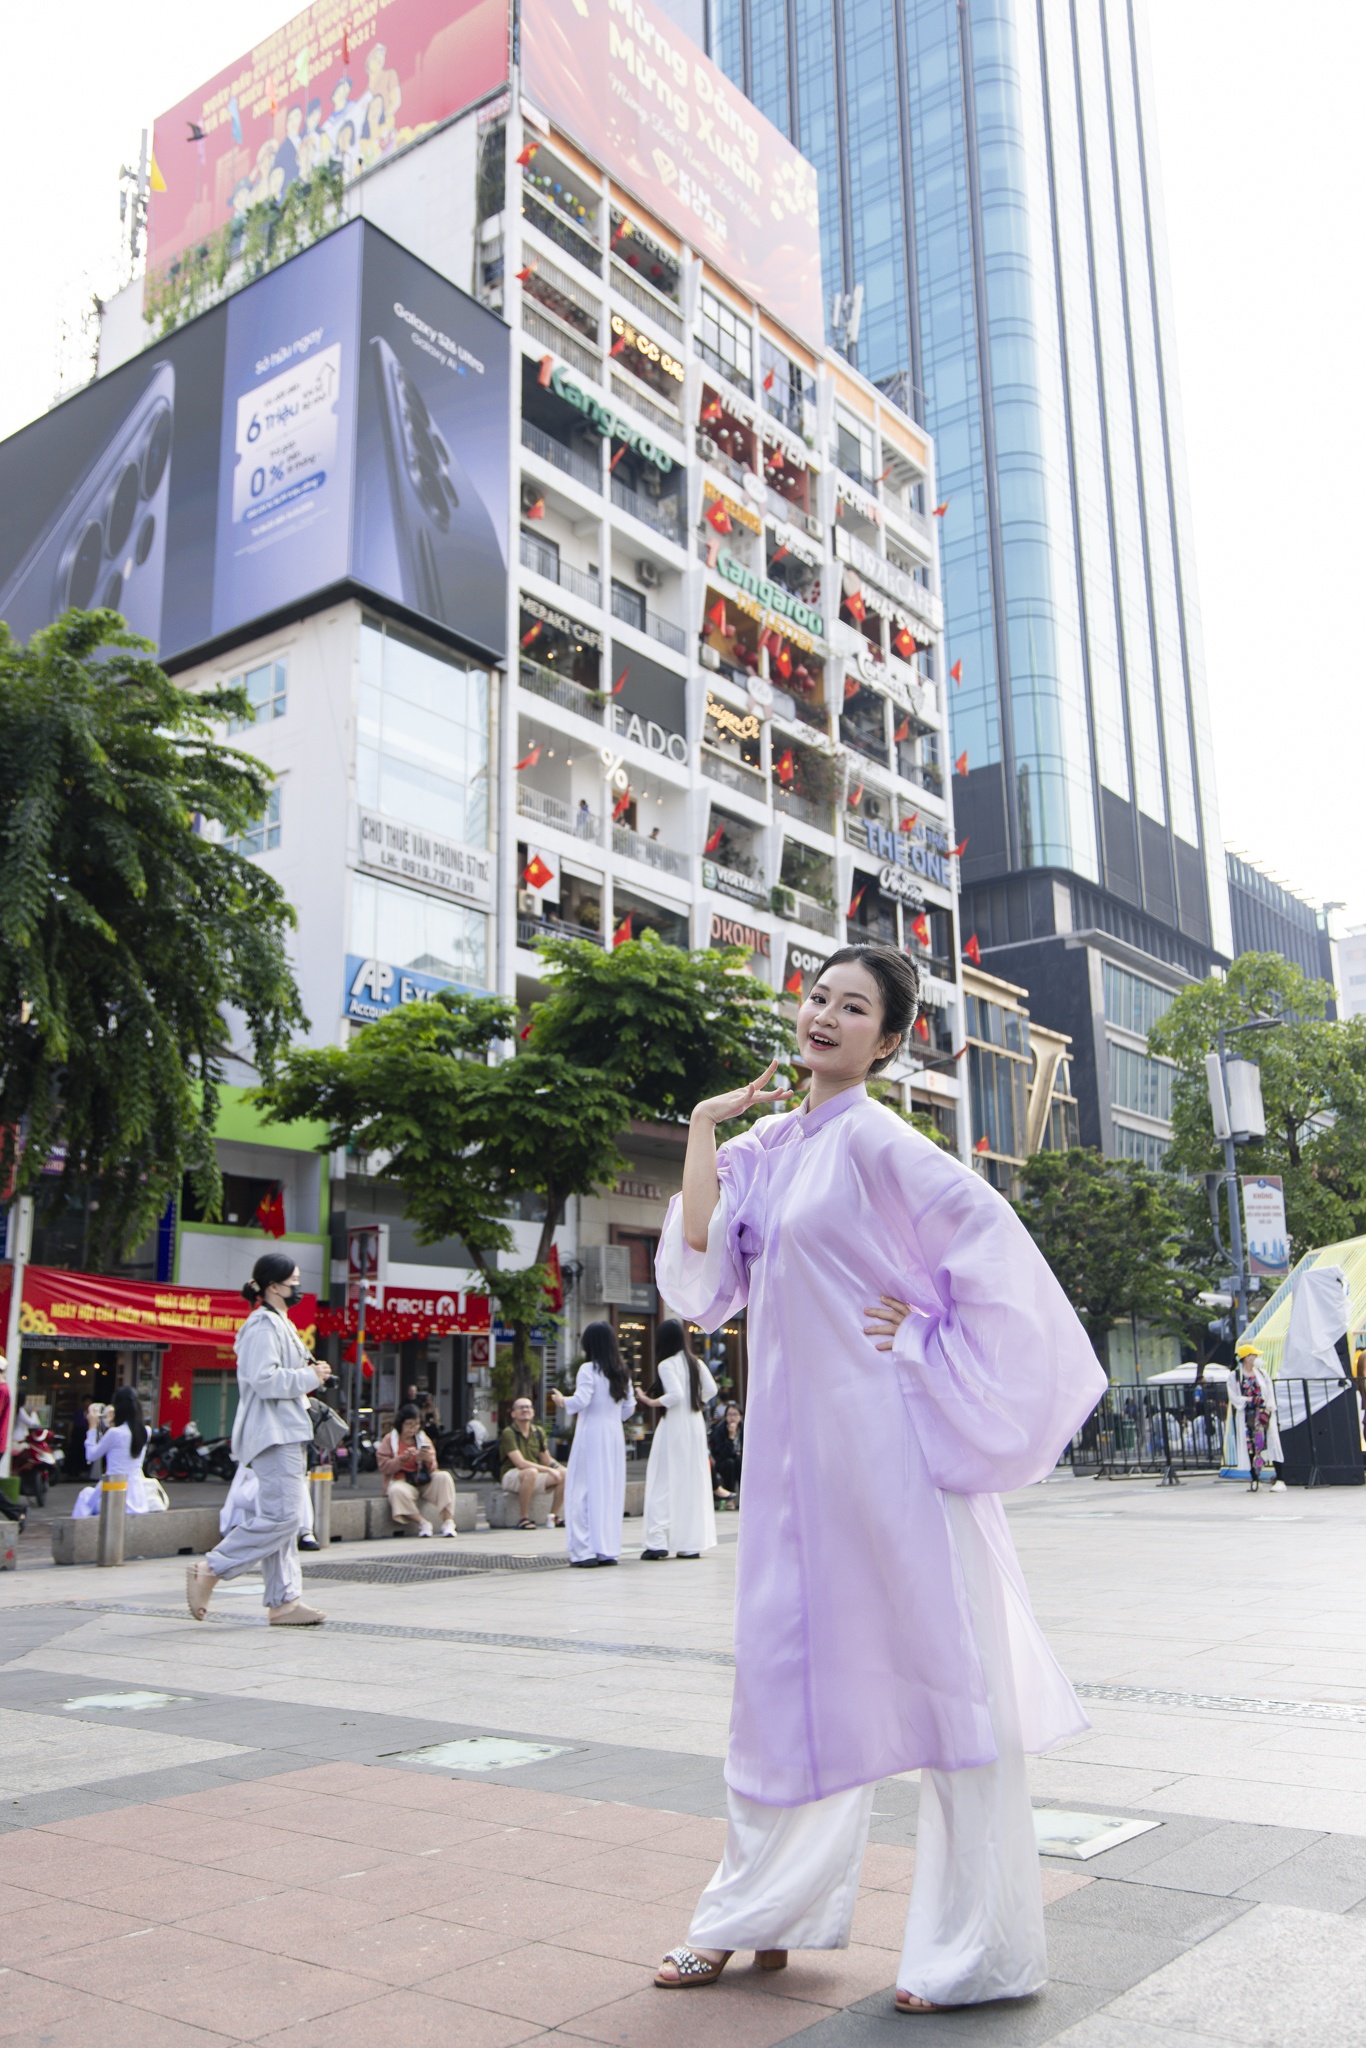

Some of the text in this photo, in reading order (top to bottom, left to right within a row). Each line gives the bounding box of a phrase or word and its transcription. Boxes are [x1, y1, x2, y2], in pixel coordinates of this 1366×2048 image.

[609, 20, 764, 197] Mừng Xuân
[694, 63, 759, 165] Đảng
[394, 302, 437, 343] Galaxy
[246, 411, 261, 443] 6
[250, 467, 265, 498] 0
[706, 538, 823, 635] Kangaroo
[765, 609, 815, 654] LETTER
[361, 816, 383, 845] CHO
[862, 818, 907, 866] THE
[910, 843, 952, 889] ONE
[386, 1298, 435, 1317] CIRCLE
